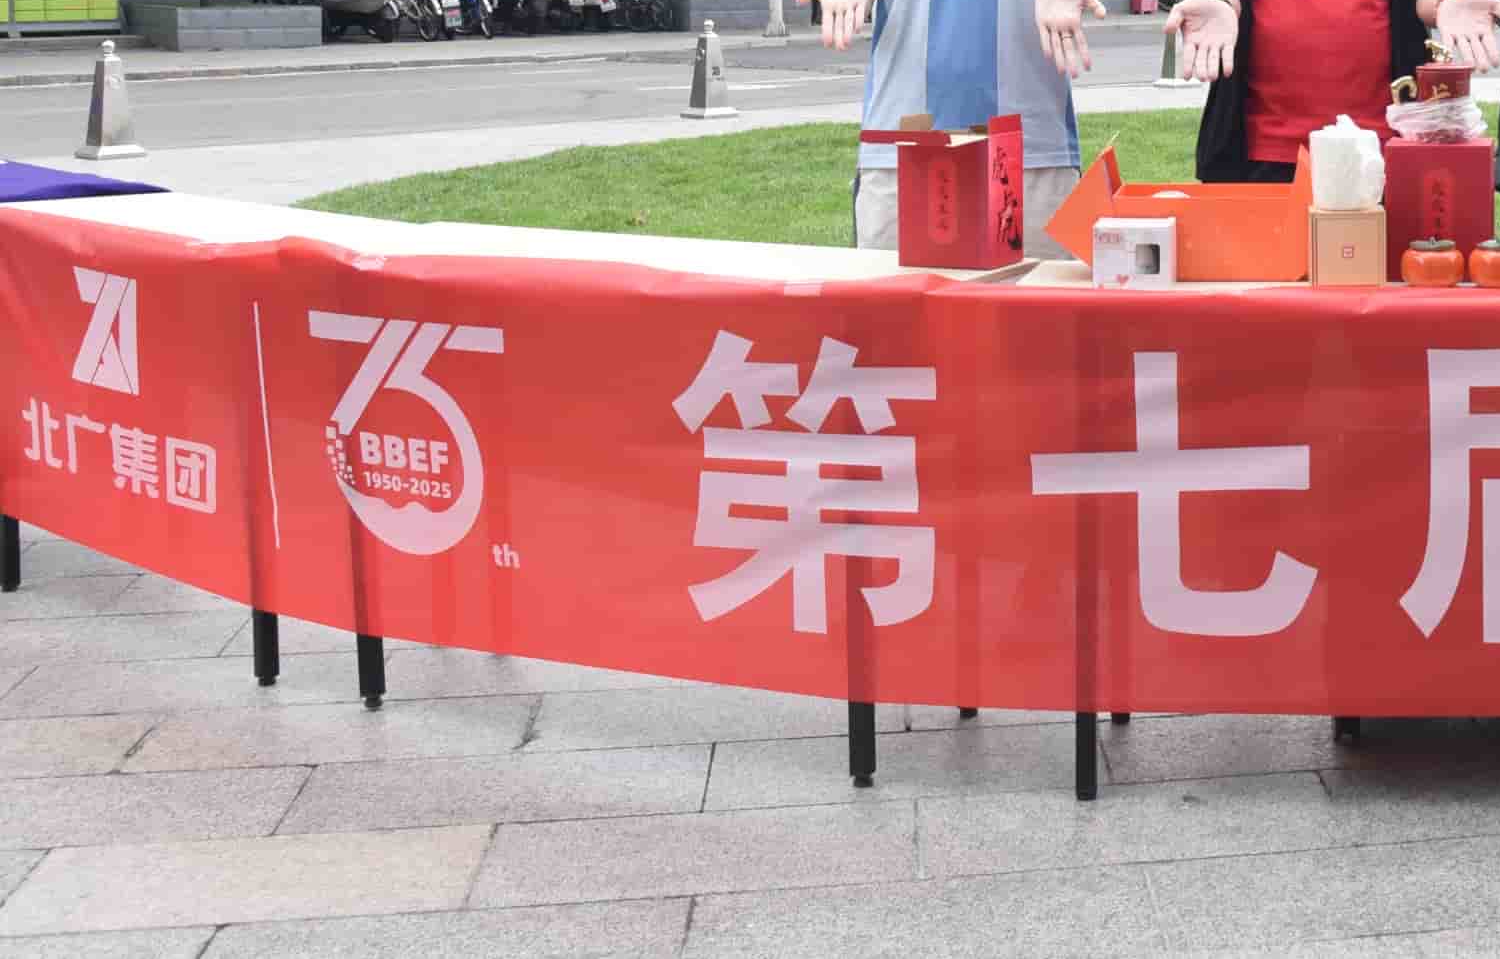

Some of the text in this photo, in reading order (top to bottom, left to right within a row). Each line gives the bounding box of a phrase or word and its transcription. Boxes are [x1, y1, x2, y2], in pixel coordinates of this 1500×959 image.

[308, 310, 504, 555] 75
[359, 431, 449, 474] BBEF
[21, 397, 217, 514] 北广集团
[363, 470, 452, 499] 1950-2025
[493, 543, 521, 569] th
